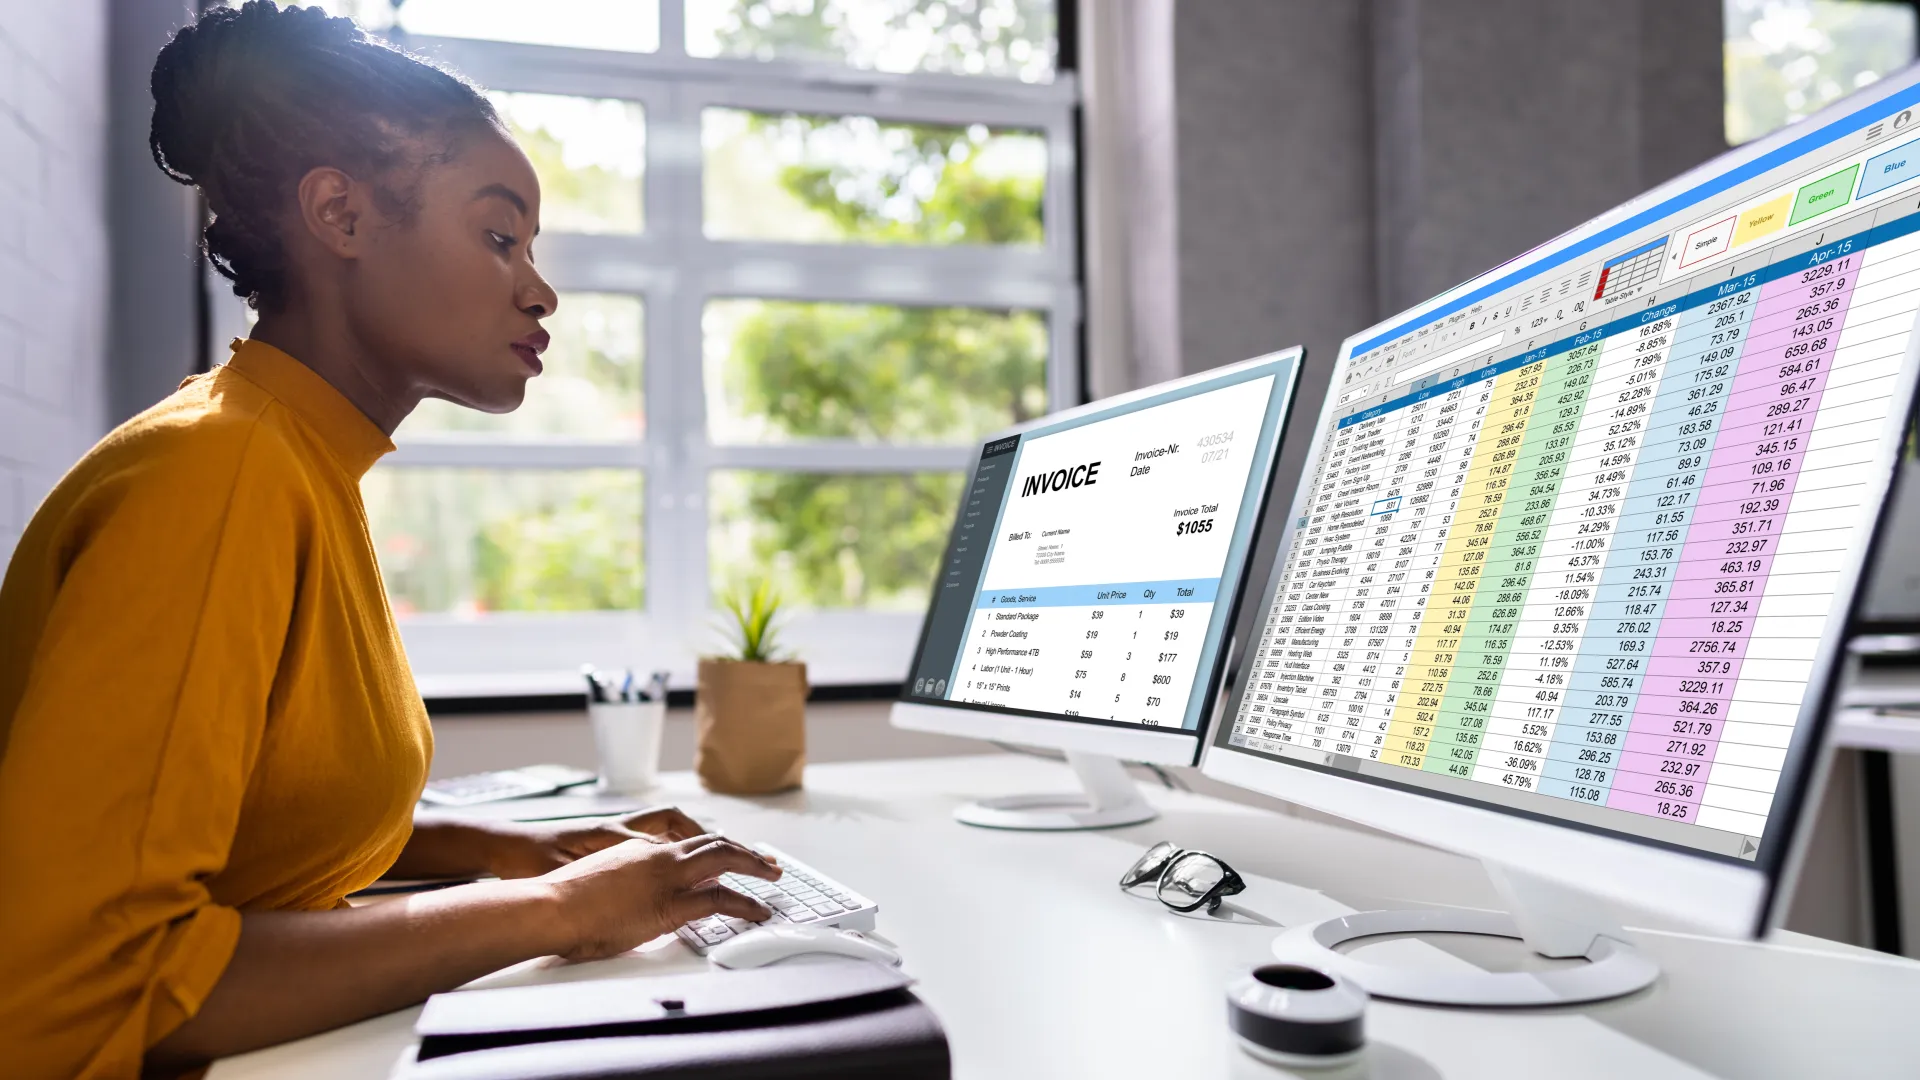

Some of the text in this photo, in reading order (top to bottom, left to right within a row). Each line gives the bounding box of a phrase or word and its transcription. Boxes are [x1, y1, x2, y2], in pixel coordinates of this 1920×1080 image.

[1694, 159, 1907, 250] Simple Yellow Green Blue
[1453, 368, 1459, 377] D
[1486, 355, 1494, 365] E
[1527, 341, 1535, 350] F
[1579, 321, 1587, 331] G
[1647, 296, 1656, 306] H
[1815, 232, 1824, 246] J
[1470, 305, 1482, 315] Help
[1604, 289, 1634, 305] Table Style
[1418, 390, 1430, 400] Low
[1451, 378, 1465, 389] High
[1481, 366, 1497, 379] Units
[1522, 348, 1547, 365] Jan-15
[1574, 329, 1603, 346] Feb-15
[1641, 303, 1677, 323] Change
[1717, 274, 1756, 297] Mar-15
[1808, 239, 1853, 265] Apr-15
[1485, 258, 1852, 389] 75 357.95 3057.64 2367.92 3229.11
[1531, 317, 1544, 329] 123
[1635, 277, 1846, 353] -8.85% 357.9
[1710, 297, 1840, 346] 73.79 265.36
[1557, 317, 1834, 404] 452.92 143.05
[1694, 337, 1828, 383] 175.92 659.68
[1610, 357, 1821, 418] -14.89% 584.61
[1688, 377, 1817, 417] 46.25 96.47
[1538, 397, 1811, 466] 205.93 35.12% 289.27
[1678, 418, 1803, 453] 73.09 121.41
[993, 440, 1016, 452] INVOICE
[1134, 430, 1234, 461] Invoice-Nr. 430534
[1130, 448, 1230, 477] Date 07/21
[1594, 437, 1798, 484] 18.49% 345.15
[1666, 458, 1792, 489] 61.46 109.16
[1021, 461, 1101, 498] INVOICE
[1173, 503, 1219, 518] Invoice Total
[1580, 478, 1786, 517] -10.33% 71.96
[1655, 498, 1780, 525] 81.55 192.39
[1008, 531, 1032, 542] Billed To:
[1176, 518, 1214, 537] $1055
[1510, 545, 1537, 557] 364.35
[1731, 519, 1773, 535] 351.71
[1641, 547, 1674, 561] 153.76
[1725, 539, 1768, 554] 232.97
[1305, 592, 1319, 600] Center
[1565, 571, 1595, 583] 11.54%
[1720, 559, 1762, 574] 463.19
[1627, 580, 1754, 597] 215.74 365.81
[1018, 595, 1036, 603] Service
[1096, 591, 1110, 600] Unit
[1110, 591, 1127, 599] Price
[1143, 589, 1156, 600] Qty
[1176, 587, 1195, 597] Total
[1710, 600, 1749, 613] 127.34
[996, 612, 1017, 620] Standard
[1017, 612, 1039, 621] Package
[1091, 610, 1104, 620] $39
[1138, 610, 1143, 619] 1
[1169, 609, 1185, 619] $39
[1616, 620, 1744, 633] 276.02 18.25
[981, 629, 1179, 641] 2 Powder Coating $19 1 $19
[1540, 639, 1737, 653] -12.53% 2756.74
[977, 646, 1177, 663] 3 High Performance 4TB $59 3 $177
[1606, 658, 1731, 674] 527.64 357.9
[980, 664, 994, 673] Labor
[994, 665, 1000, 674] (1
[1000, 665, 1011, 674] Unit
[1015, 666, 1018, 674] 1
[1018, 667, 1033, 676] Hour)
[1074, 669, 1088, 679] $75
[1120, 672, 1126, 682] 8
[1152, 674, 1171, 685] $600
[1678, 680, 1724, 694] 3229.11
[996, 683, 1011, 692] Prints
[1069, 689, 1081, 699] $14
[1114, 694, 1120, 703] 5
[1146, 696, 1161, 707] $70
[1594, 694, 1719, 715] 203.79 364.26
[1527, 707, 1713, 736] 117.17 521.79
[1586, 731, 1707, 756] 153.68 271.92
[1266, 718, 1694, 798] Policy Privacy 128.78 265.36
[1660, 760, 1701, 777] 232.97
[1262, 730, 1282, 740] Response
[1570, 786, 1600, 802] 115.08
[1657, 801, 1688, 818] 18.25
